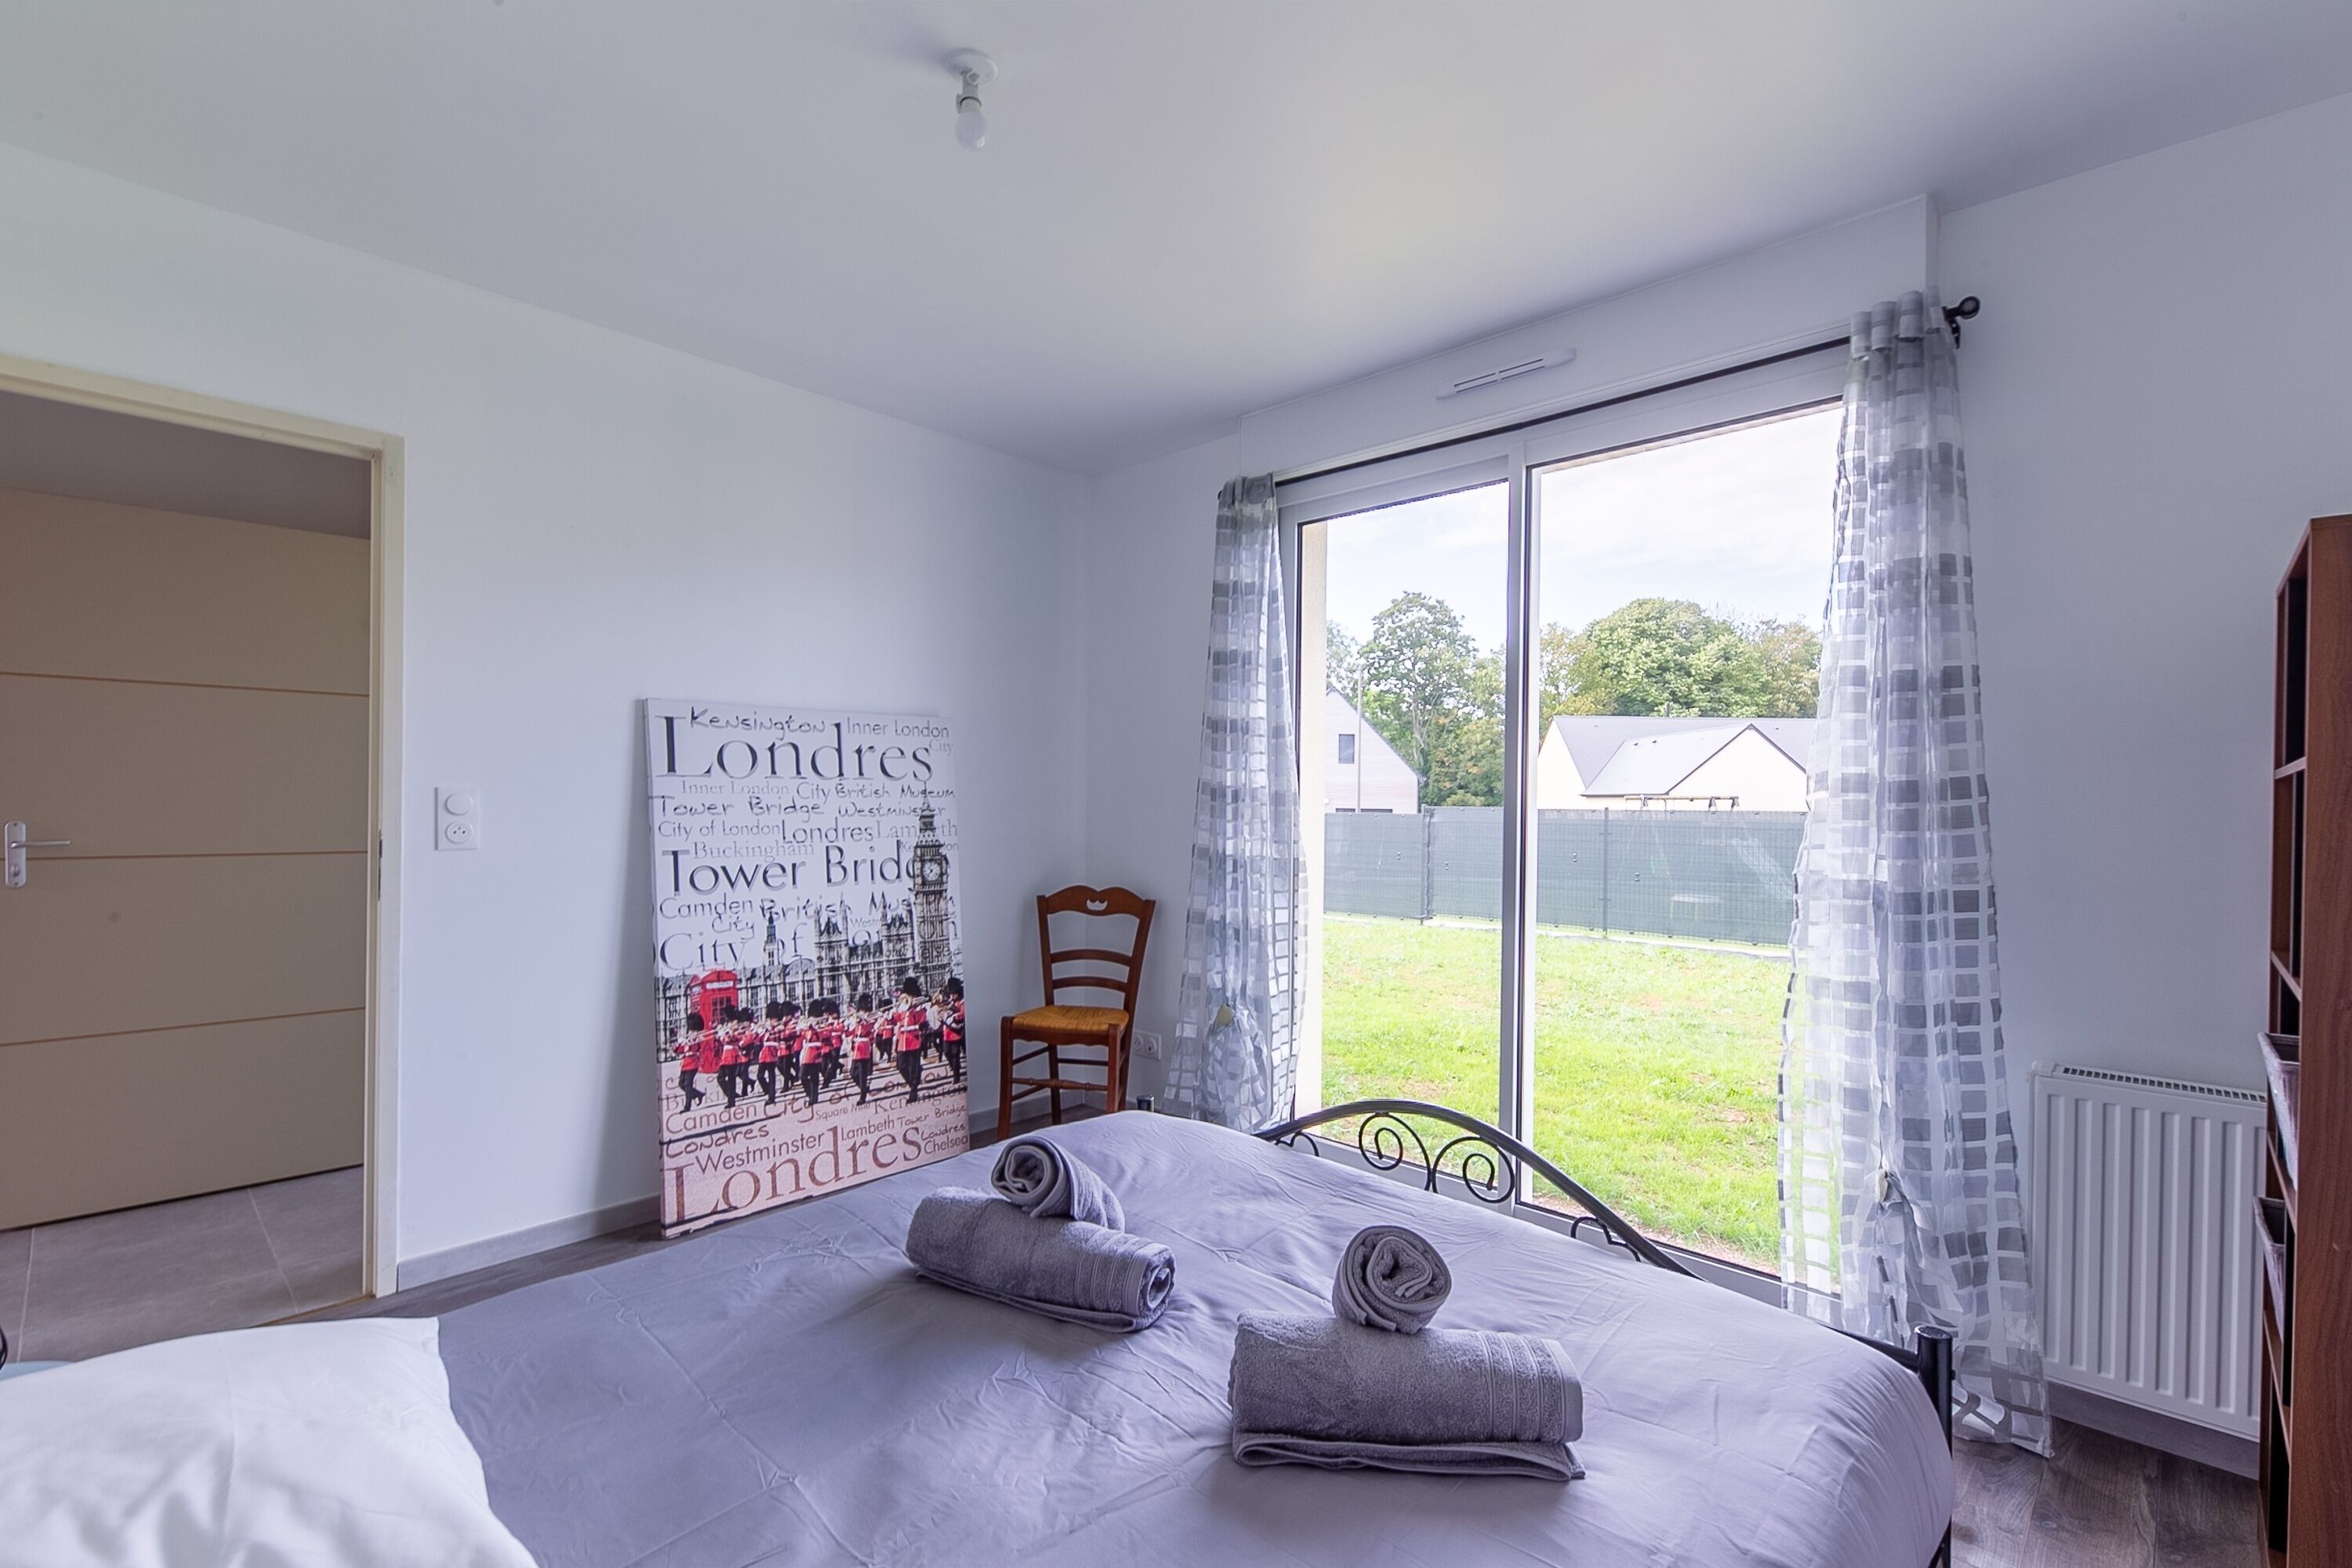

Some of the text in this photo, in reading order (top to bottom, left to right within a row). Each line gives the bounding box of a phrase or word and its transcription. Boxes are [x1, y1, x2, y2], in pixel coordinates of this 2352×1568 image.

[691, 706, 826, 742] Kensington
[847, 716, 950, 739] Inner London
[655, 714, 934, 782] Londres
[681, 779, 789, 795] Inner London
[796, 781, 831, 806] City
[834, 781, 891, 799] British
[649, 794, 826, 824] Tower Bridge
[658, 818, 781, 842] City of London
[782, 816, 874, 844] Londres
[875, 818, 958, 840] Lamth
[694, 840, 815, 863] Buckingham
[661, 849, 807, 897] Tower
[659, 892, 754, 920] Camden
[711, 915, 755, 940] City
[659, 931, 750, 971] City
[666, 1102, 757, 1134] Camden
[841, 1114, 895, 1142] Lambeth
[898, 1103, 967, 1127] Tower Bridge
[666, 1123, 770, 1159] Londres
[695, 1129, 825, 1174] Westminster
[924, 1134, 968, 1155] Chelsea
[662, 1125, 921, 1223] Londres
